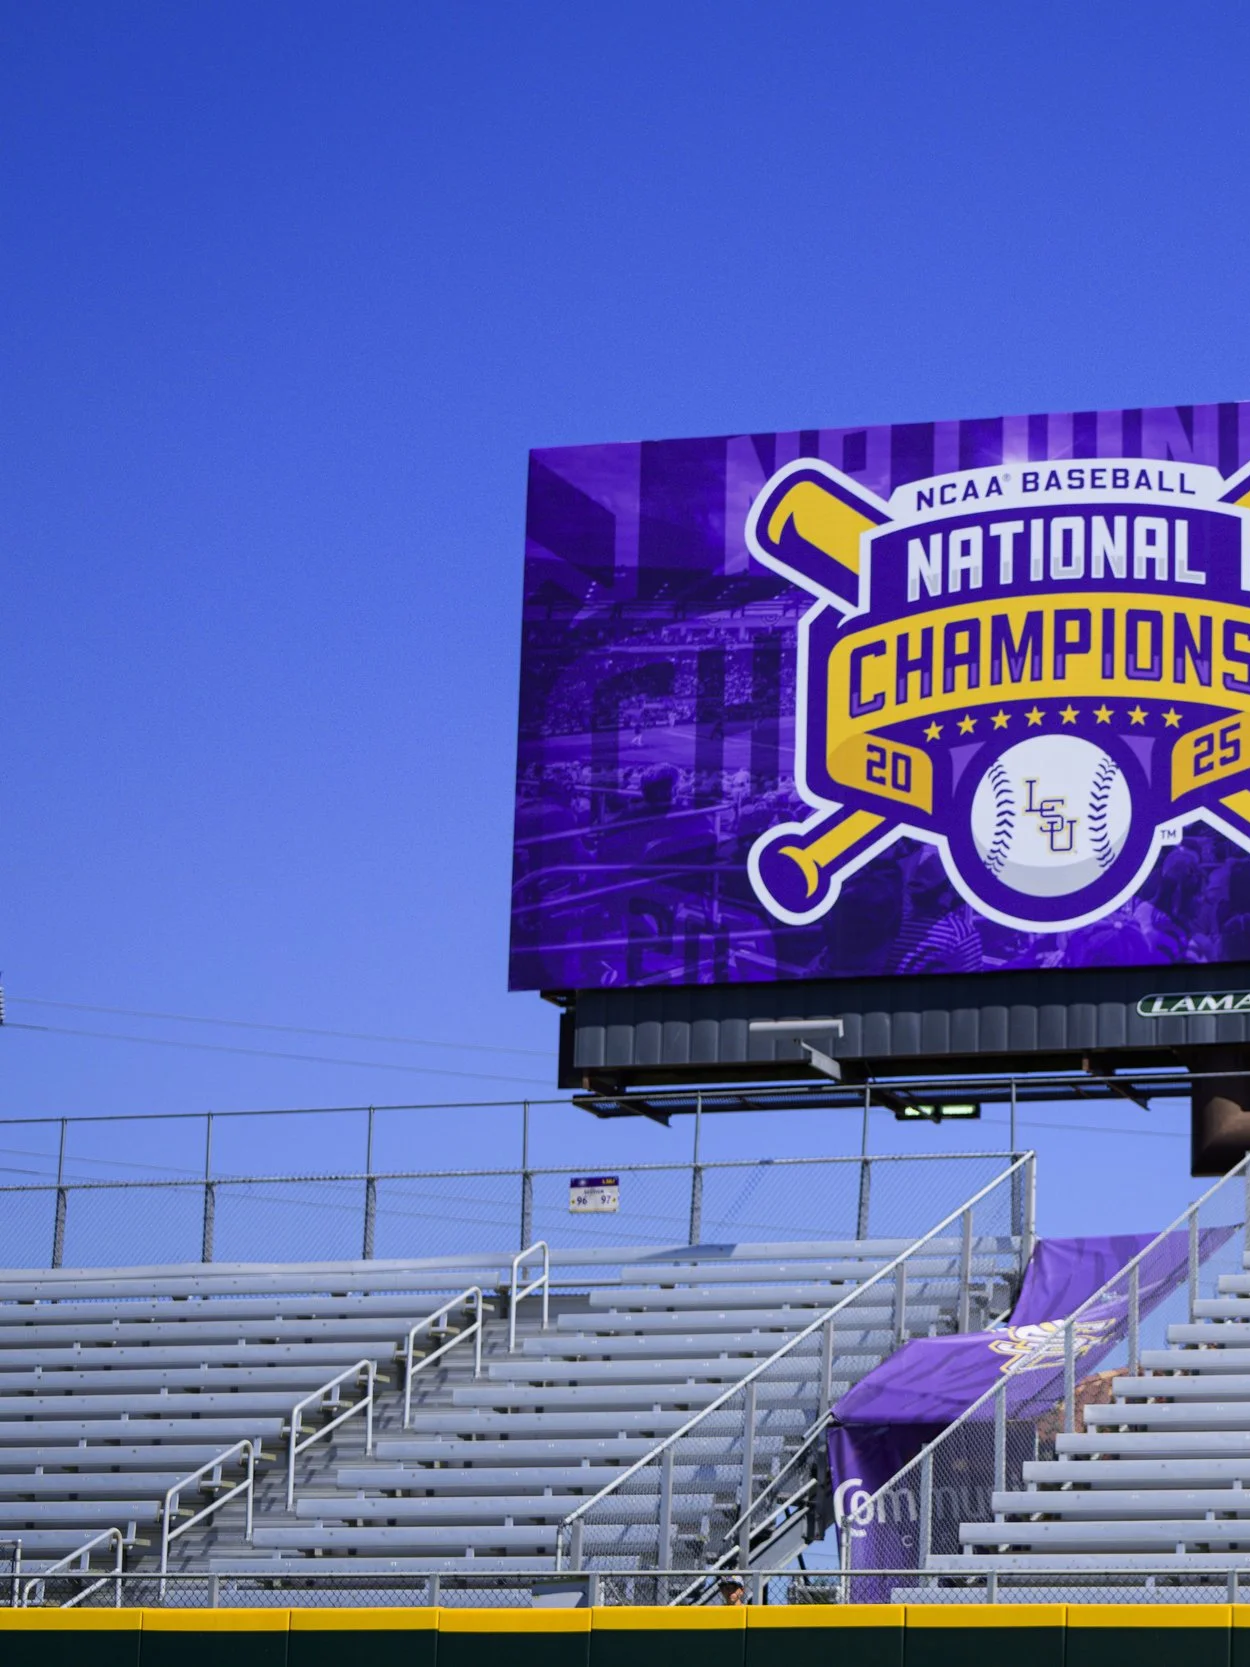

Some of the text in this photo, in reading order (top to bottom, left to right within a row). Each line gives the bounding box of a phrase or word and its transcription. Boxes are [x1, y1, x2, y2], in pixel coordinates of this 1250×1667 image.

[1021, 467, 1197, 495] BASEBALL
[907, 515, 1207, 603] NATIONAL
[865, 721, 1242, 793] 20 25
[1022, 777, 1079, 853] LSU
[1159, 828, 1177, 840] TM
[577, 1196, 588, 1205] 96
